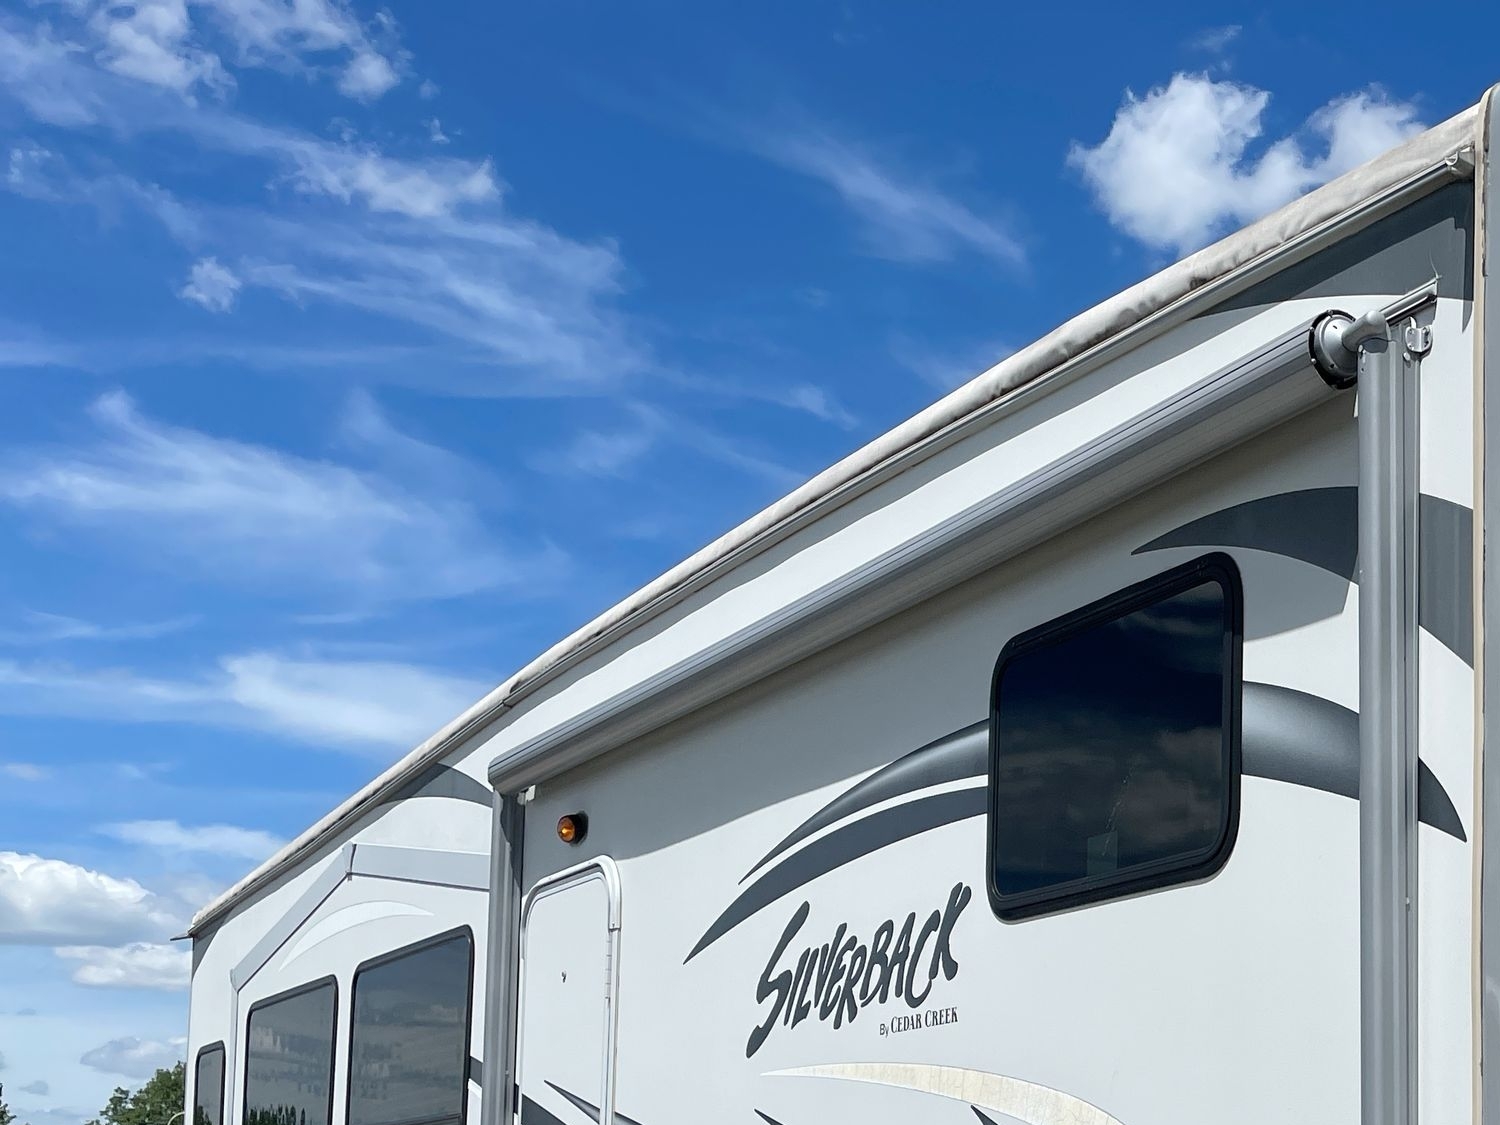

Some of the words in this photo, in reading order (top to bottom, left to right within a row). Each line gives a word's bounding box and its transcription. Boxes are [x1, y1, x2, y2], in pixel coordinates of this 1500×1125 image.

[745, 881, 972, 1059] SILVERBACK
[879, 1023, 889, 1038] By
[890, 1013, 922, 1033] CEDAR
[924, 1006, 958, 1028] CREEK
